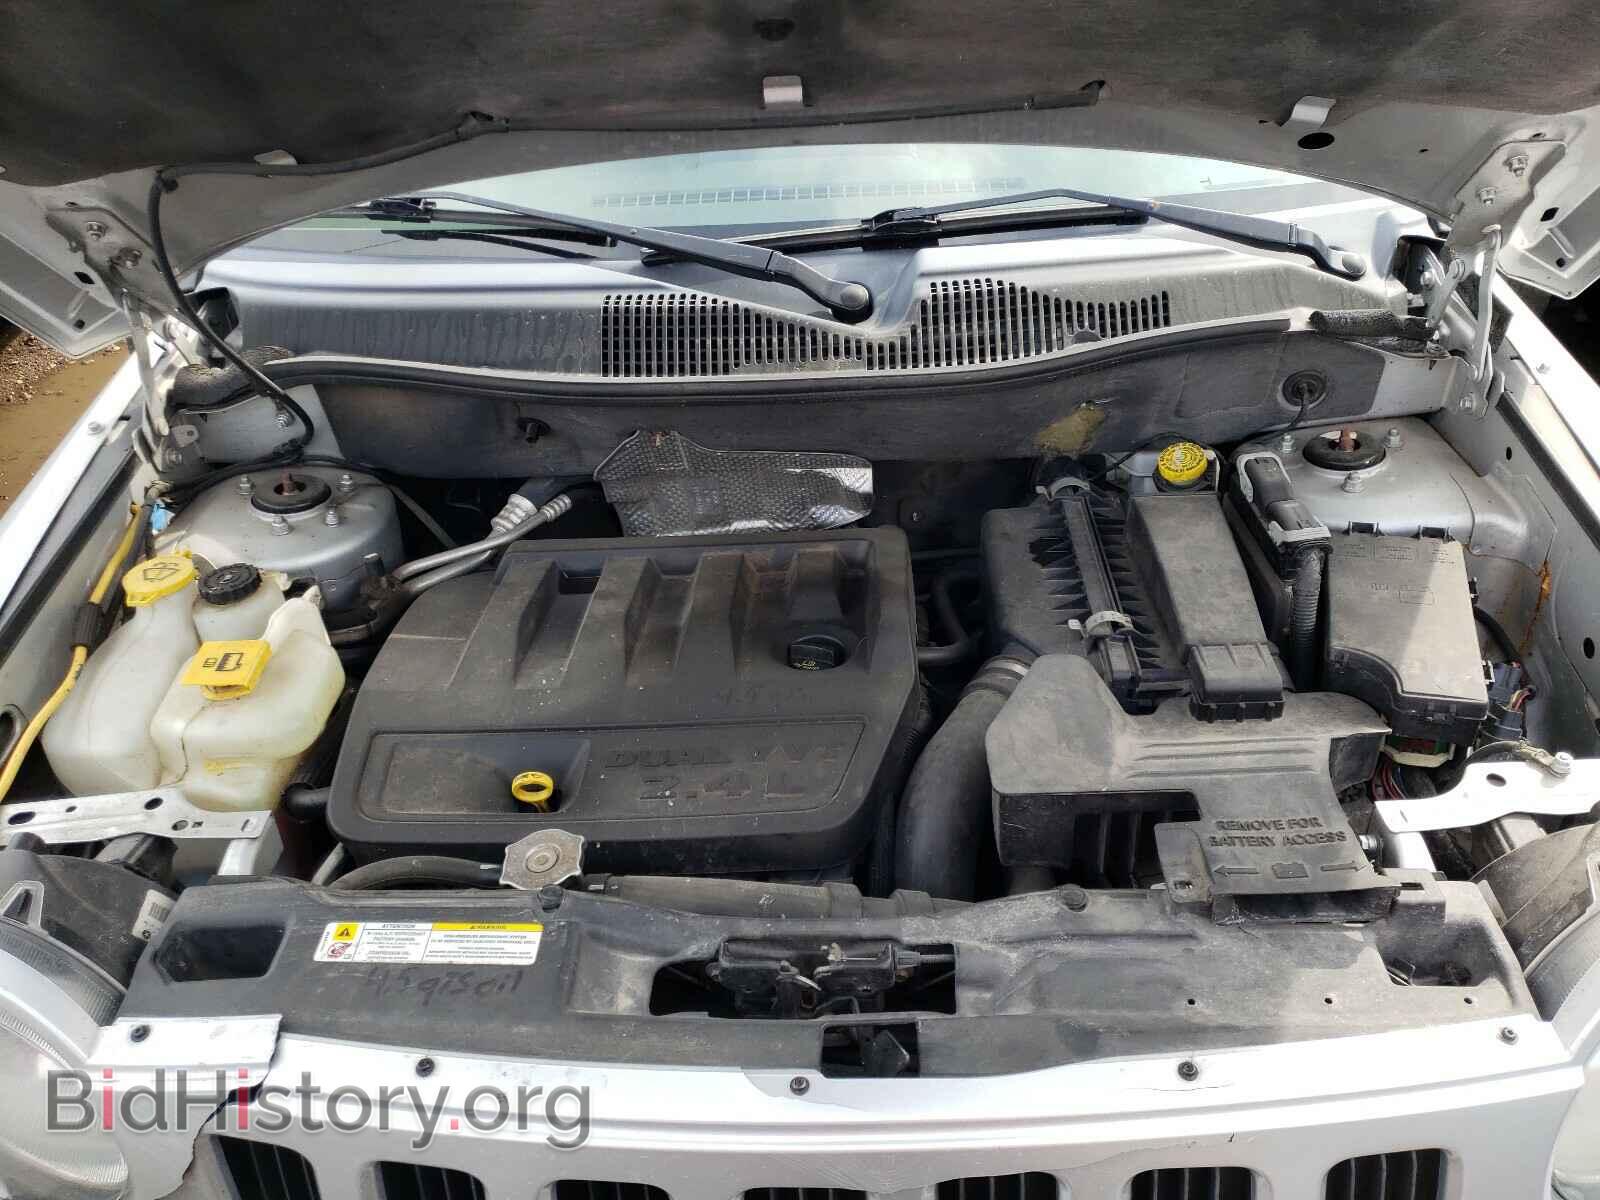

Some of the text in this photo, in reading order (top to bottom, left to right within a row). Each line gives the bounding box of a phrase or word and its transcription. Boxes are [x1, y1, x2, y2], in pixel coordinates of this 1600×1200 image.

[1215, 817, 1323, 831] REMOVE FOR
[1208, 831, 1348, 848] BATTERY ACCESS
